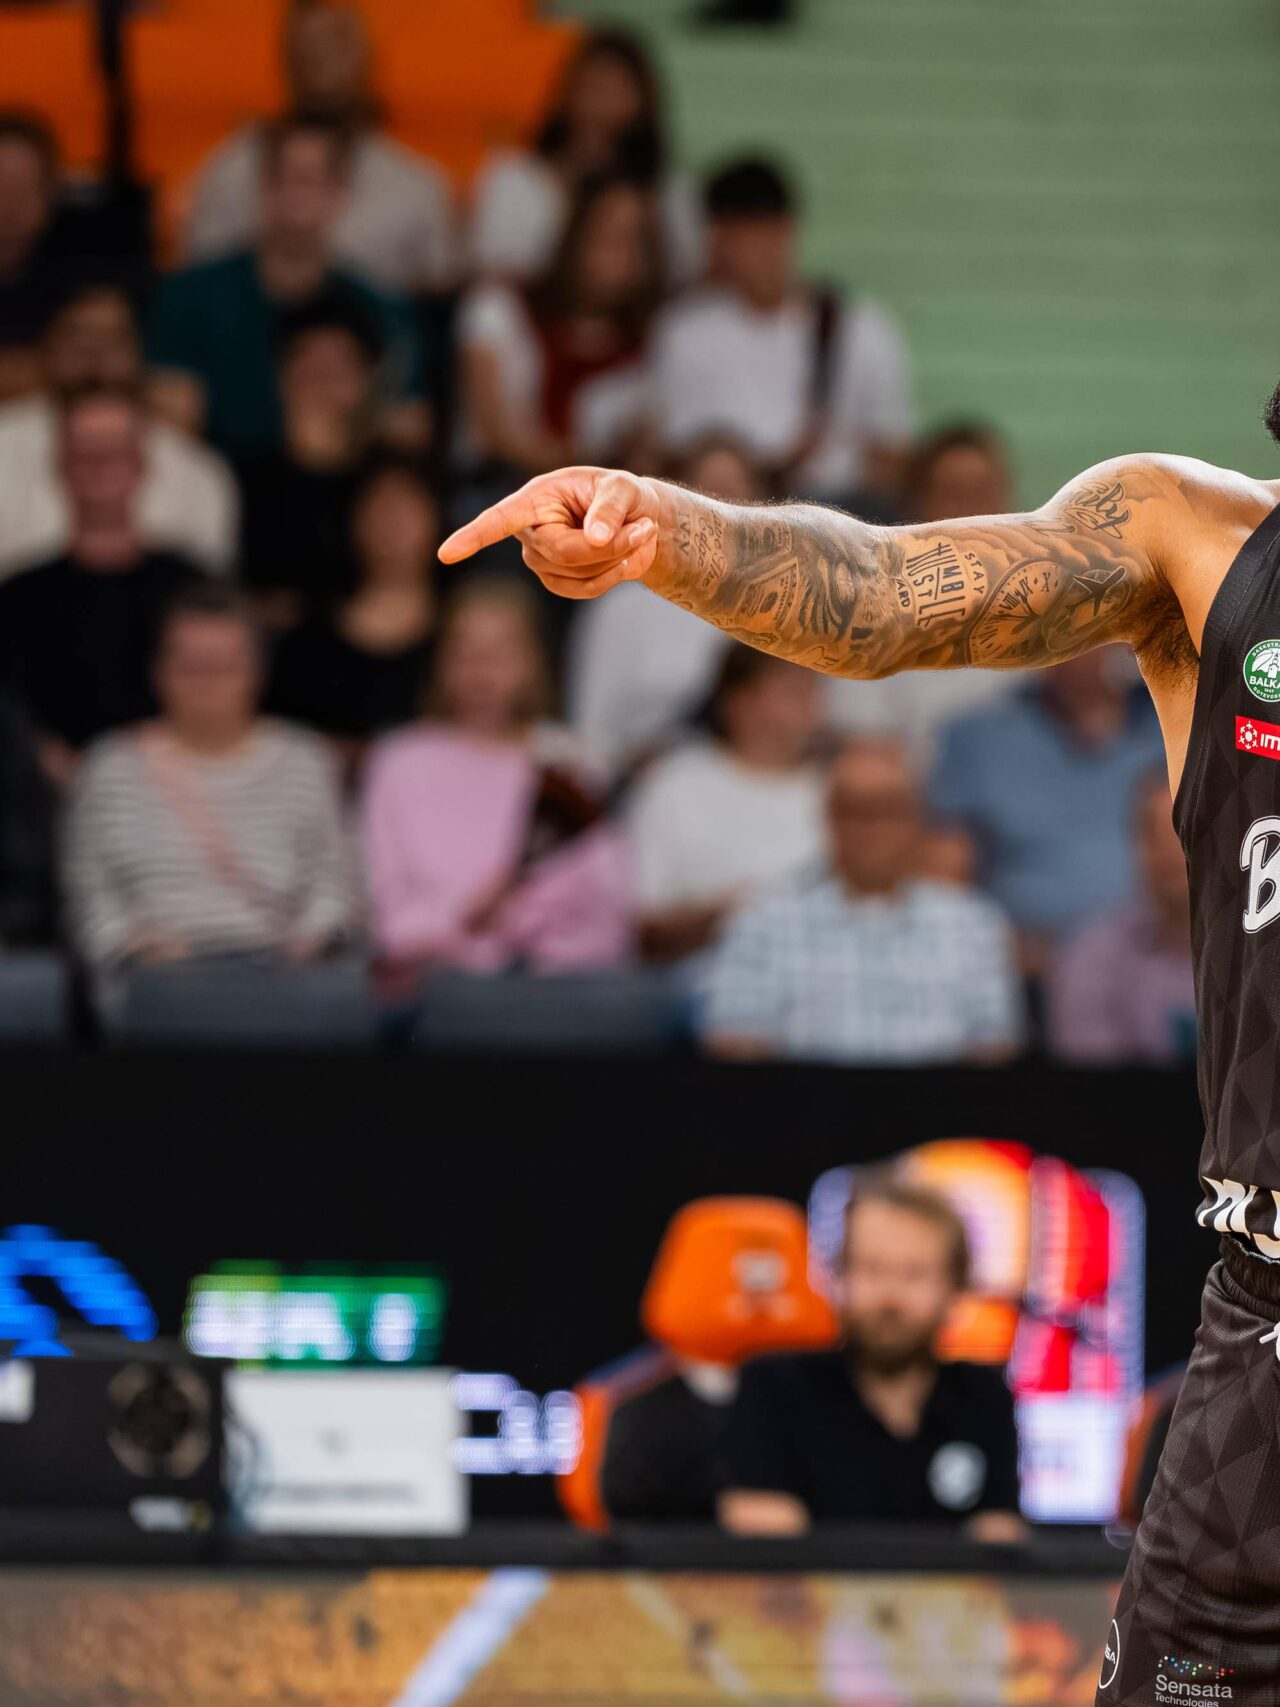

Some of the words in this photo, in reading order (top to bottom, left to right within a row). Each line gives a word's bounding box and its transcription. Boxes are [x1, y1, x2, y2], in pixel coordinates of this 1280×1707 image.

[965, 552, 985, 594] STAY
[1104, 1643, 1116, 1665] SA
[1155, 1674, 1233, 1699] Sensata
[1154, 1691, 1220, 1707] Technologies
